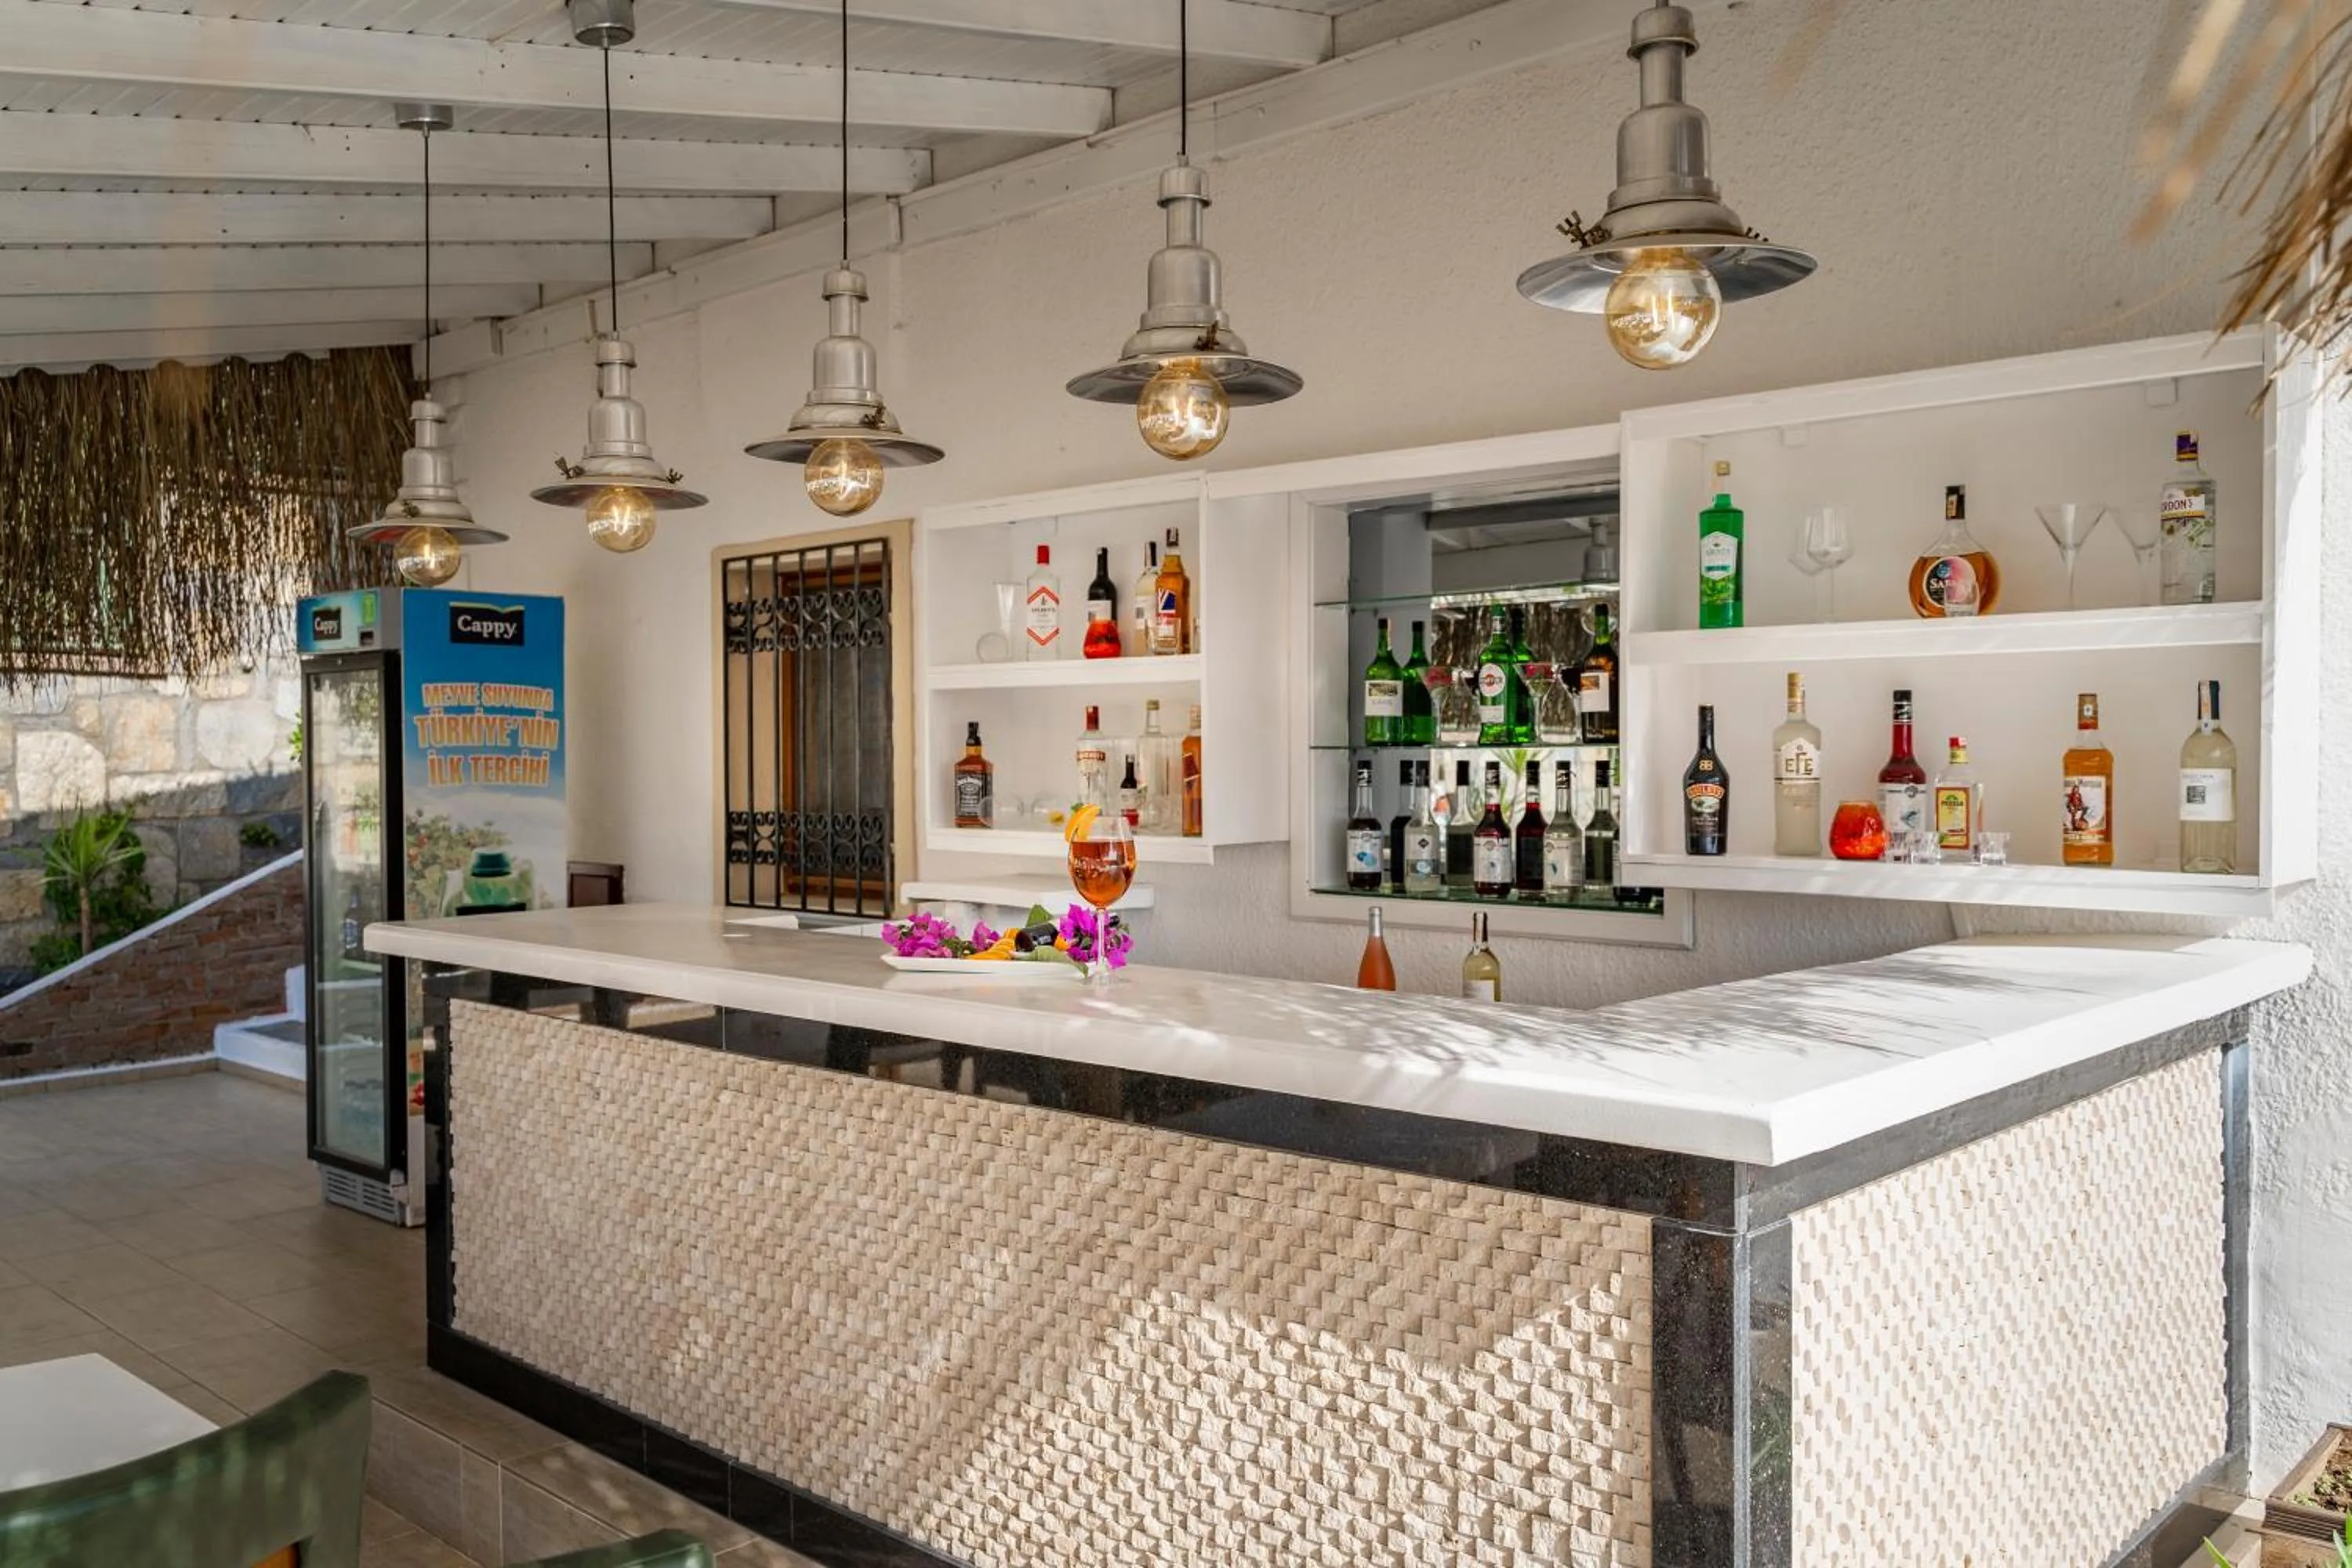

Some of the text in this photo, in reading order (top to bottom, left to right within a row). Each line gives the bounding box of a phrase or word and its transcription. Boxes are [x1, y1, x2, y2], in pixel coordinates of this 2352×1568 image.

[456, 614, 517, 640] Cappy
[422, 682, 554, 712] MEYVE SUYUNDA
[414, 707, 560, 750] TÜRKİYE'NİN
[427, 749, 550, 787] İLK TERCİHİ
